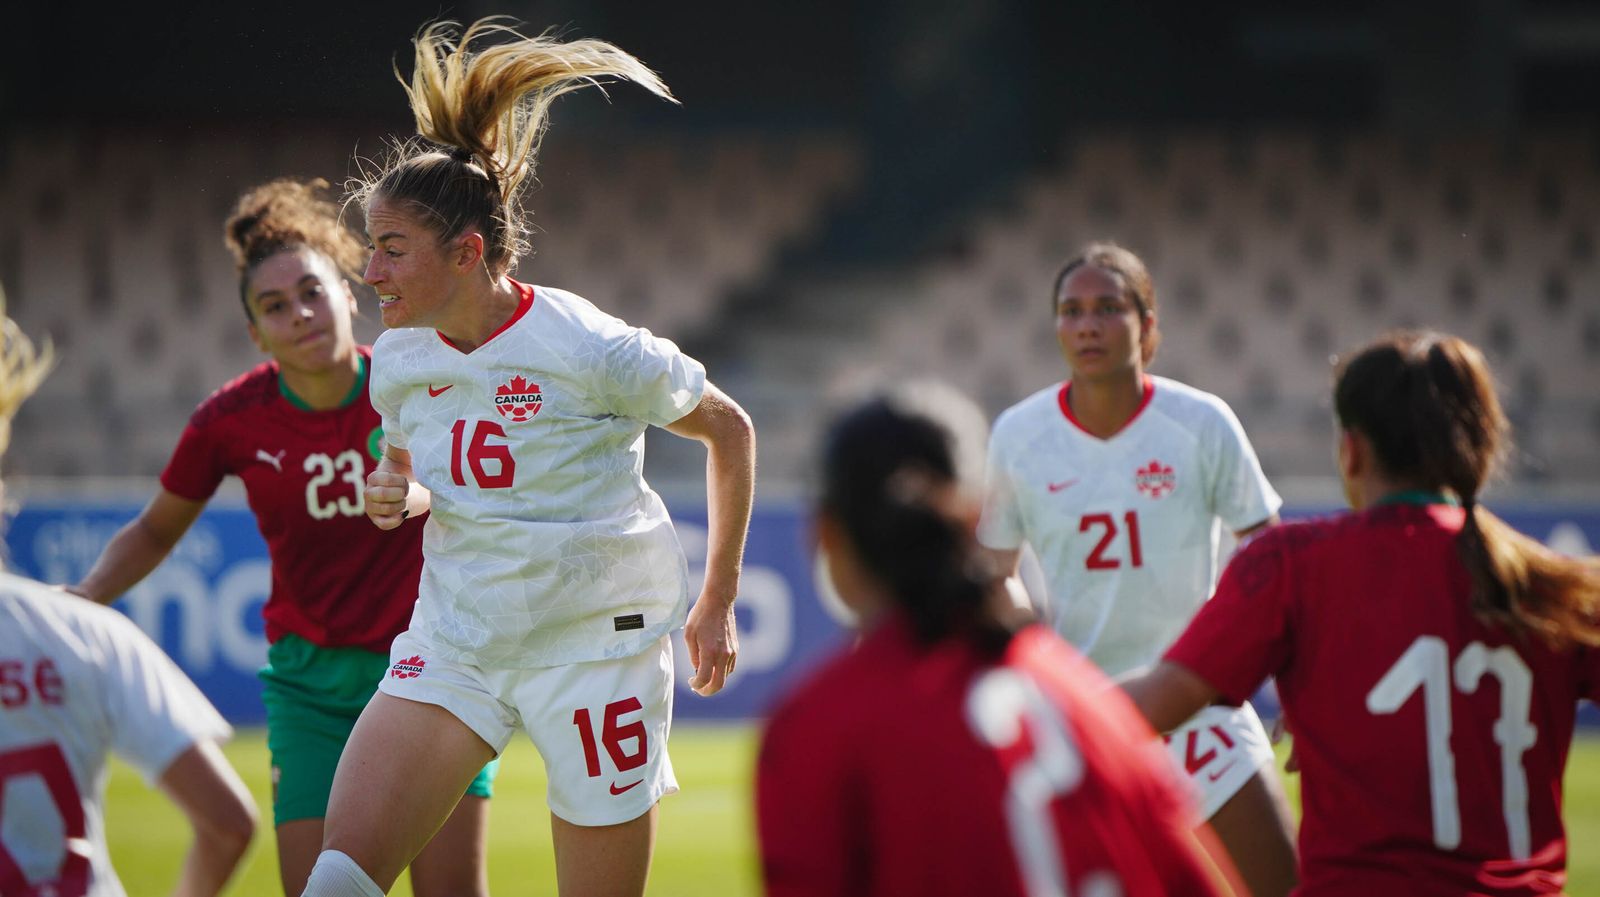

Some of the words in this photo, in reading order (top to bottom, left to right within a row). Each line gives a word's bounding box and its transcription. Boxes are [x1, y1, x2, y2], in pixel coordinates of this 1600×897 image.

[495, 394, 543, 404] CANADA
[303, 449, 366, 520] 23
[450, 419, 516, 489] 16
[1079, 509, 1143, 570] 21
[393, 664, 423, 673] CANADA
[573, 696, 648, 778] 16
[1366, 635, 1537, 863] 17
